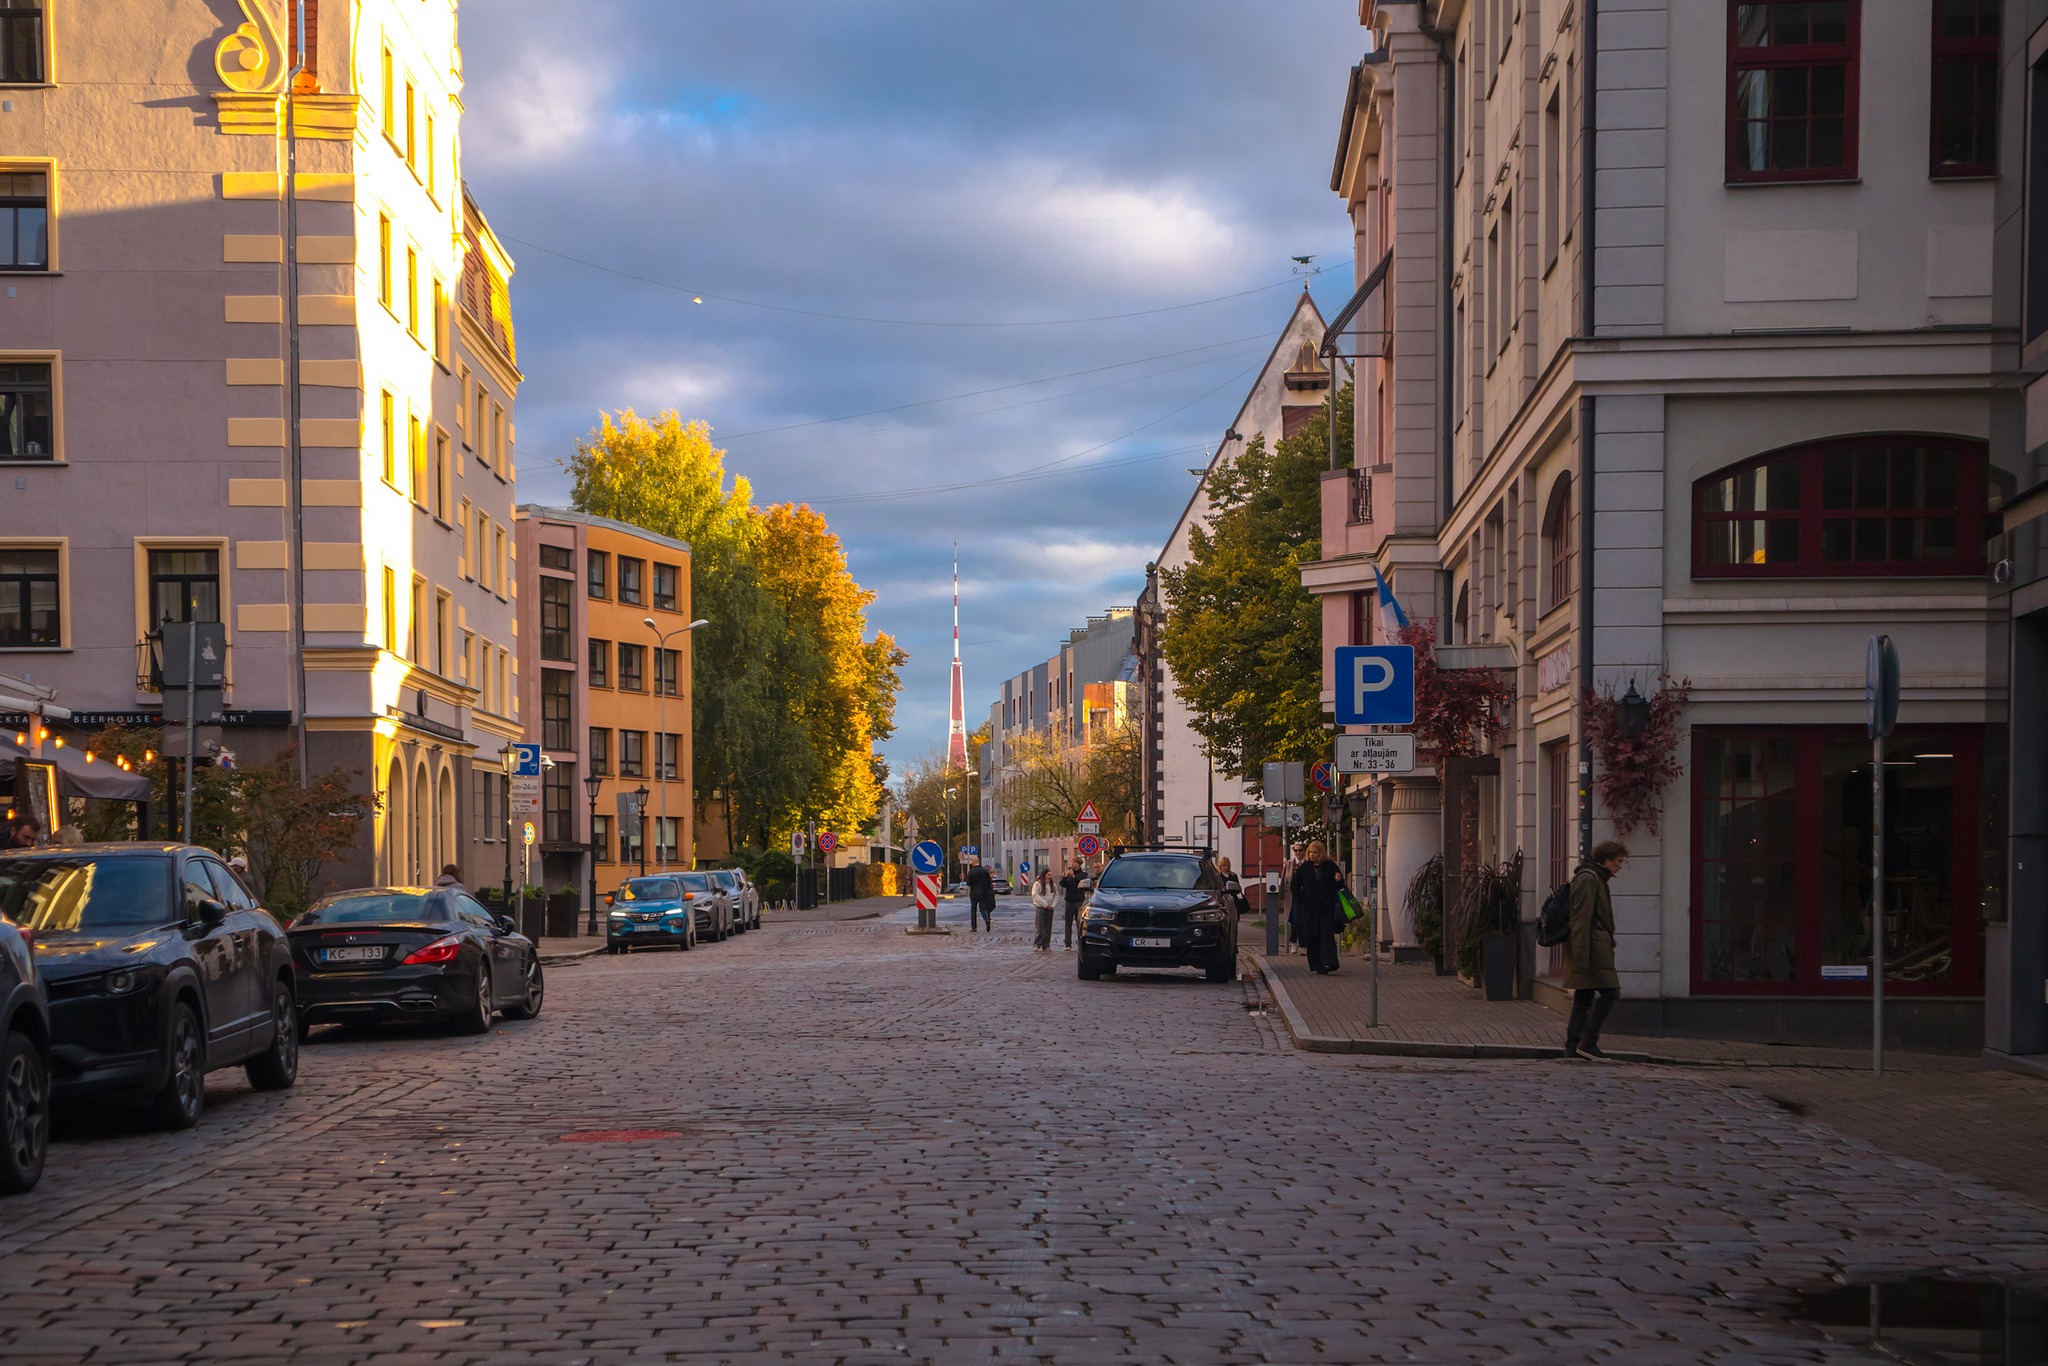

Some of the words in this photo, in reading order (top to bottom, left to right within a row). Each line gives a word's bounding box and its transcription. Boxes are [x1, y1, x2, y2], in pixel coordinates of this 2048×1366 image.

[1354, 656, 1395, 715] P
[73, 715, 150, 723] BEERHOUSE
[1364, 738, 1384, 747] Tikai
[1362, 749, 1398, 760] atļaujām
[1353, 760, 1365, 769] Nr.
